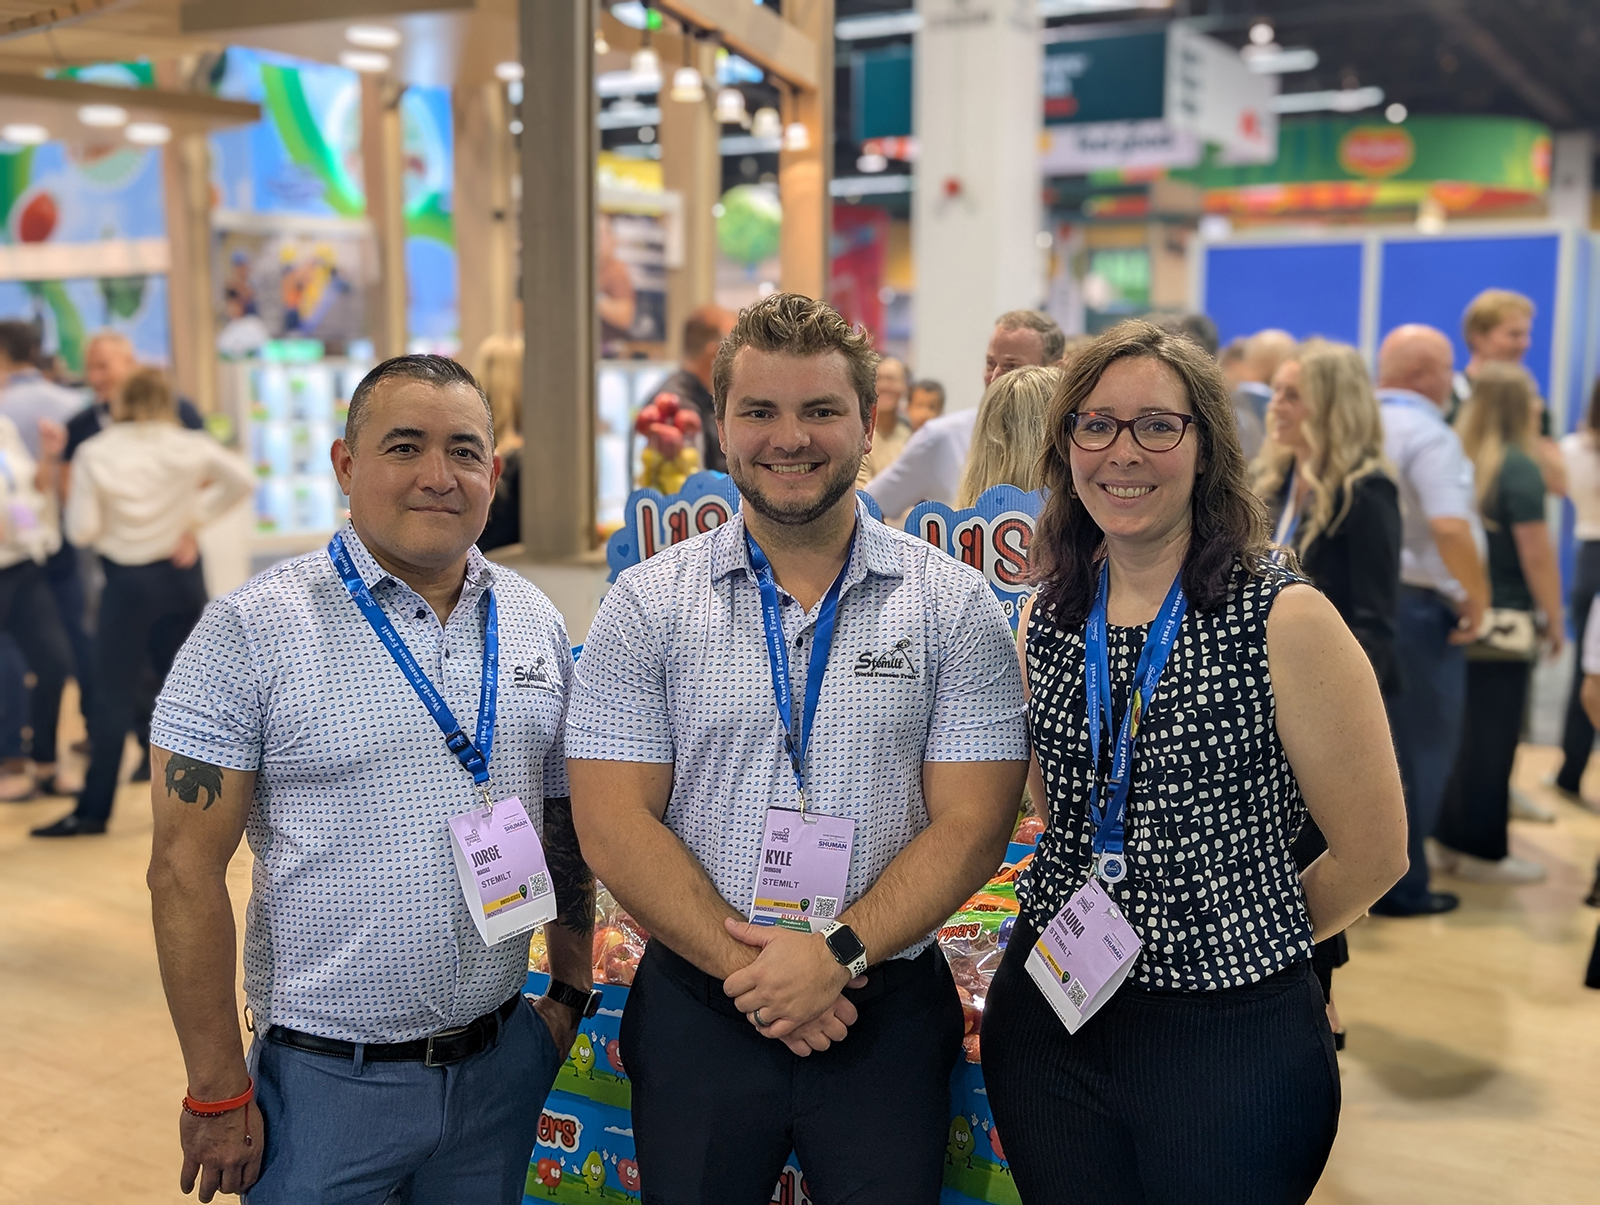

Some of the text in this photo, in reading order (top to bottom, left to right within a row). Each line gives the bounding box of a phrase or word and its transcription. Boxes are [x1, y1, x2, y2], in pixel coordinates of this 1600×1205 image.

[1160, 619, 1176, 646] Fruit
[768, 605, 787, 706] World Famous Fruit
[854, 652, 904, 671] Stemilt
[380, 625, 442, 713] World Famous Fruit
[1089, 662, 1097, 689] Fruit
[480, 653, 495, 744] World Famous Fruit
[1117, 747, 1127, 779] World
[504, 820, 528, 832] SHUMAN
[470, 844, 502, 868] JORGE
[765, 848, 793, 867] KYLE
[818, 840, 847, 850] SHUMAN
[481, 870, 512, 889] STEMILT
[762, 877, 800, 889] STEMILT
[781, 913, 809, 922] BUYER
[1048, 926, 1073, 958] STEMILT
[1103, 934, 1123, 961] SHUMAN
